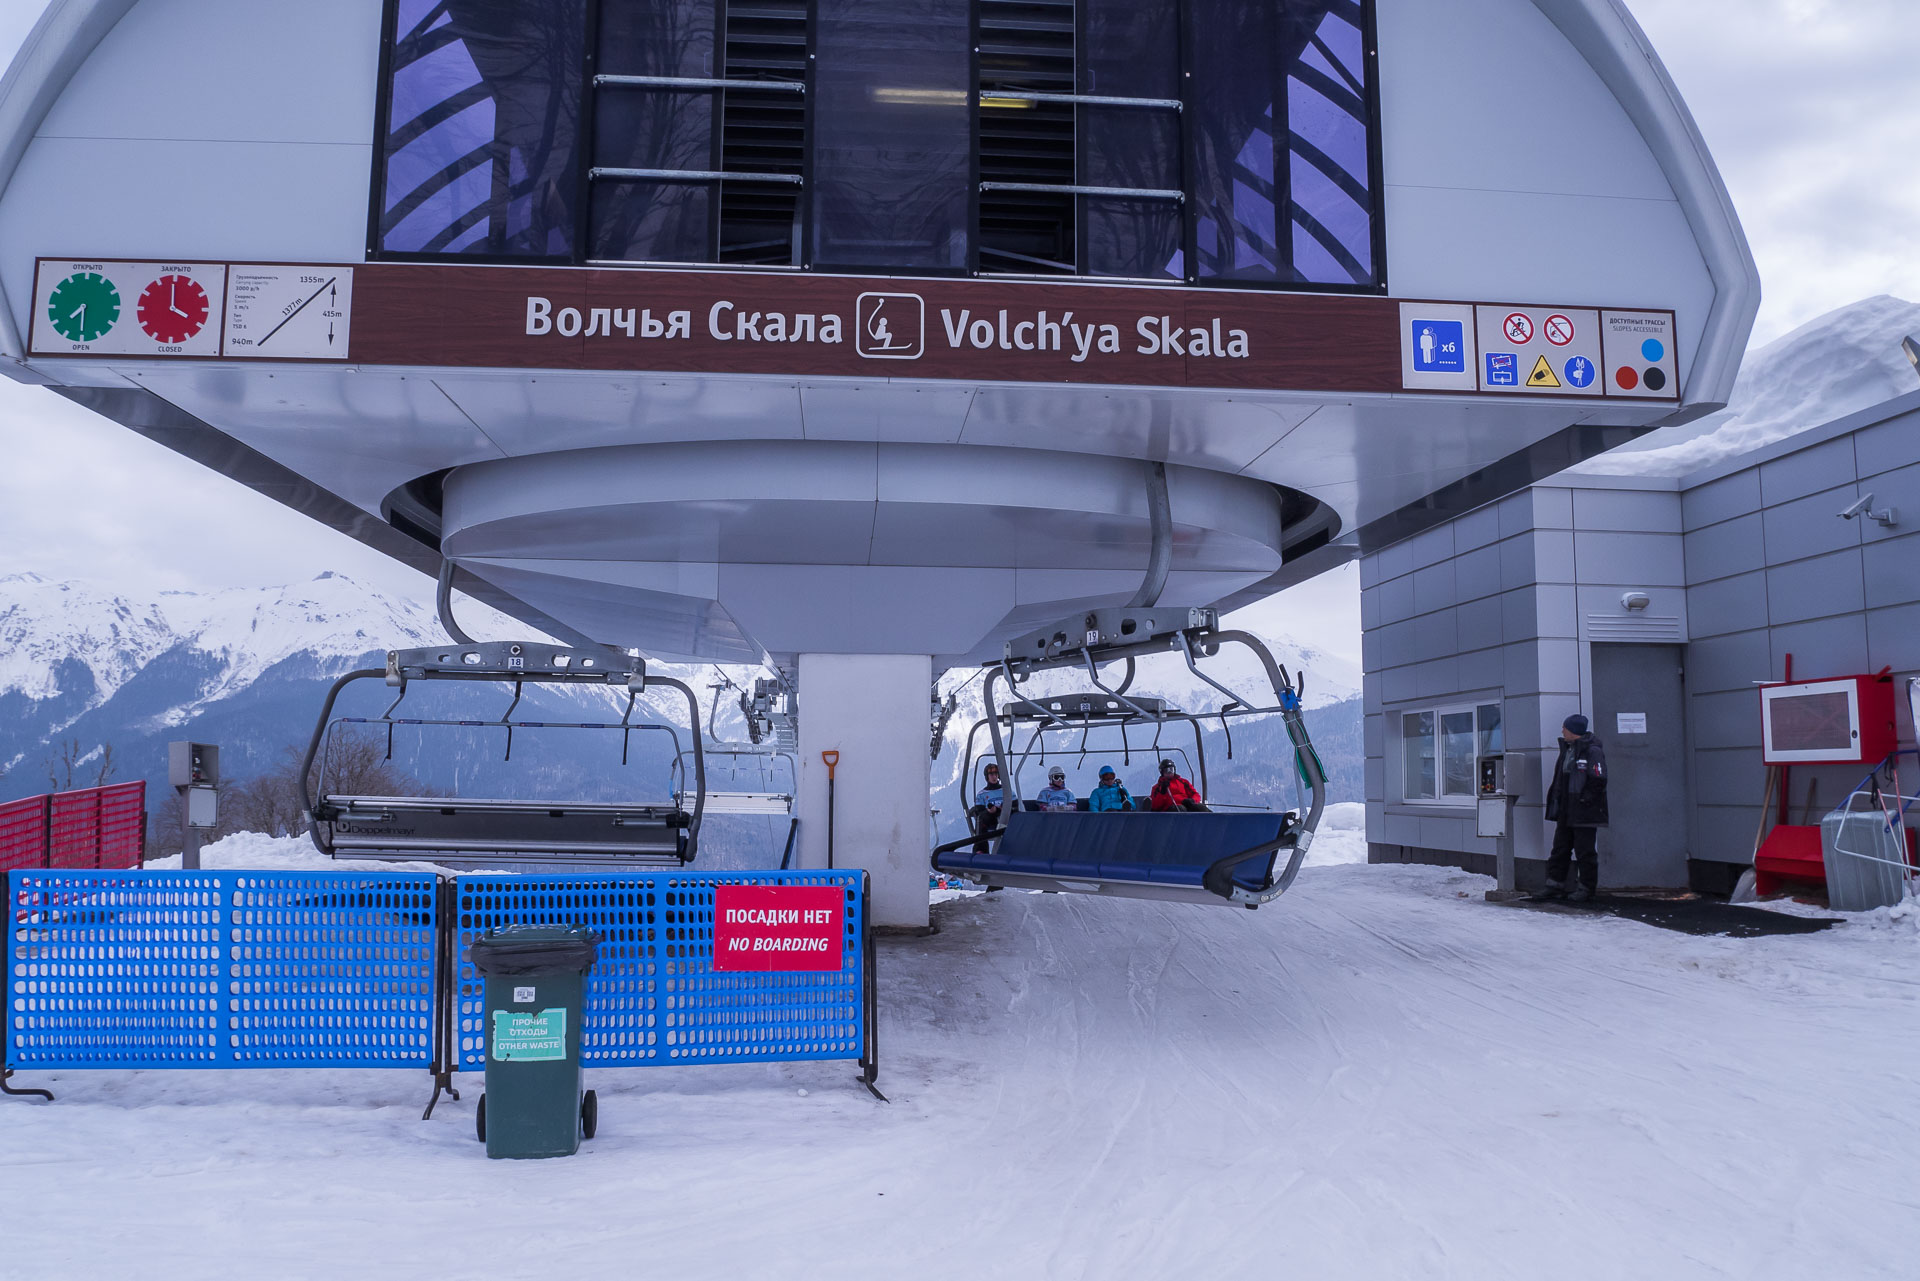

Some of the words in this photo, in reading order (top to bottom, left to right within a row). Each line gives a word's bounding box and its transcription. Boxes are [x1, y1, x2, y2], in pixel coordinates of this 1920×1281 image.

[160, 265, 192, 273] ЗАКРЫТО
[282, 298, 303, 316] 1377m
[322, 310, 342, 318] 415m
[525, 296, 691, 339] Волчья
[708, 300, 843, 344] Скала
[1609, 317, 1643, 325] ДОСТУПНЫЕ
[1136, 315, 1249, 358] Skala
[1441, 341, 1456, 353] x6
[1088, 632, 1097, 641] 19
[511, 658, 521, 666] 18
[351, 825, 416, 837] Doppelmayr
[726, 909, 799, 926] ПОСАДКИ
[804, 910, 832, 924] НЕТ
[728, 937, 750, 951] NO
[753, 937, 829, 952] BOARDING
[512, 1018, 549, 1026] ПРОЧИЕ
[509, 1028, 548, 1037] ОТХОДЫ
[498, 1042, 528, 1050] OTHER
[529, 1041, 560, 1050] WASTE
